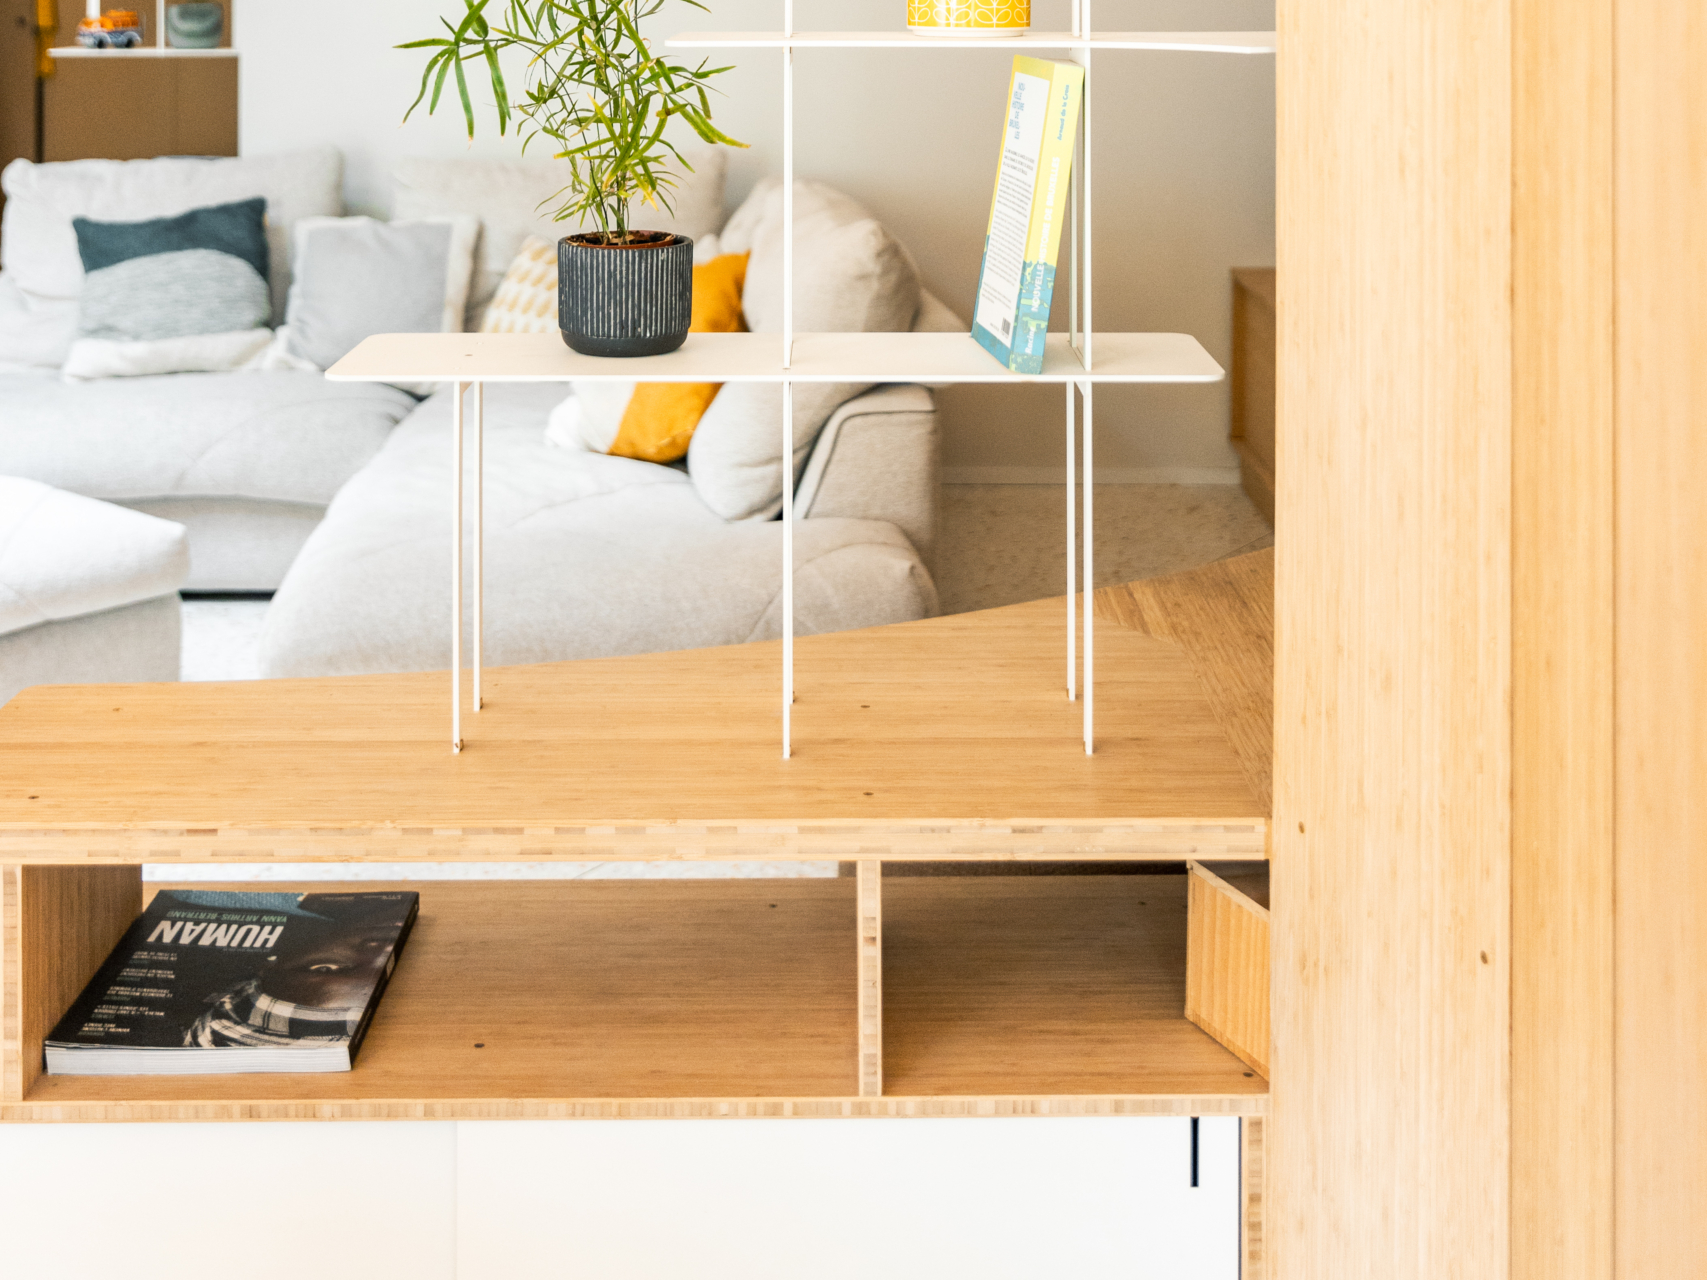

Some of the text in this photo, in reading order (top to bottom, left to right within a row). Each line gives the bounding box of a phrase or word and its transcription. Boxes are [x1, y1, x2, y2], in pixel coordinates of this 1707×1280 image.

[1056, 118, 1064, 140] Arnaud
[1060, 108, 1066, 116] de
[1031, 156, 1060, 312] NOUVELLE HISTOIRE DE BRUXELLES
[1024, 326, 1036, 354] Racine
[166, 910, 287, 922] YANN ARTHUS-BERTRAND
[146, 920, 284, 948] HUMAN
